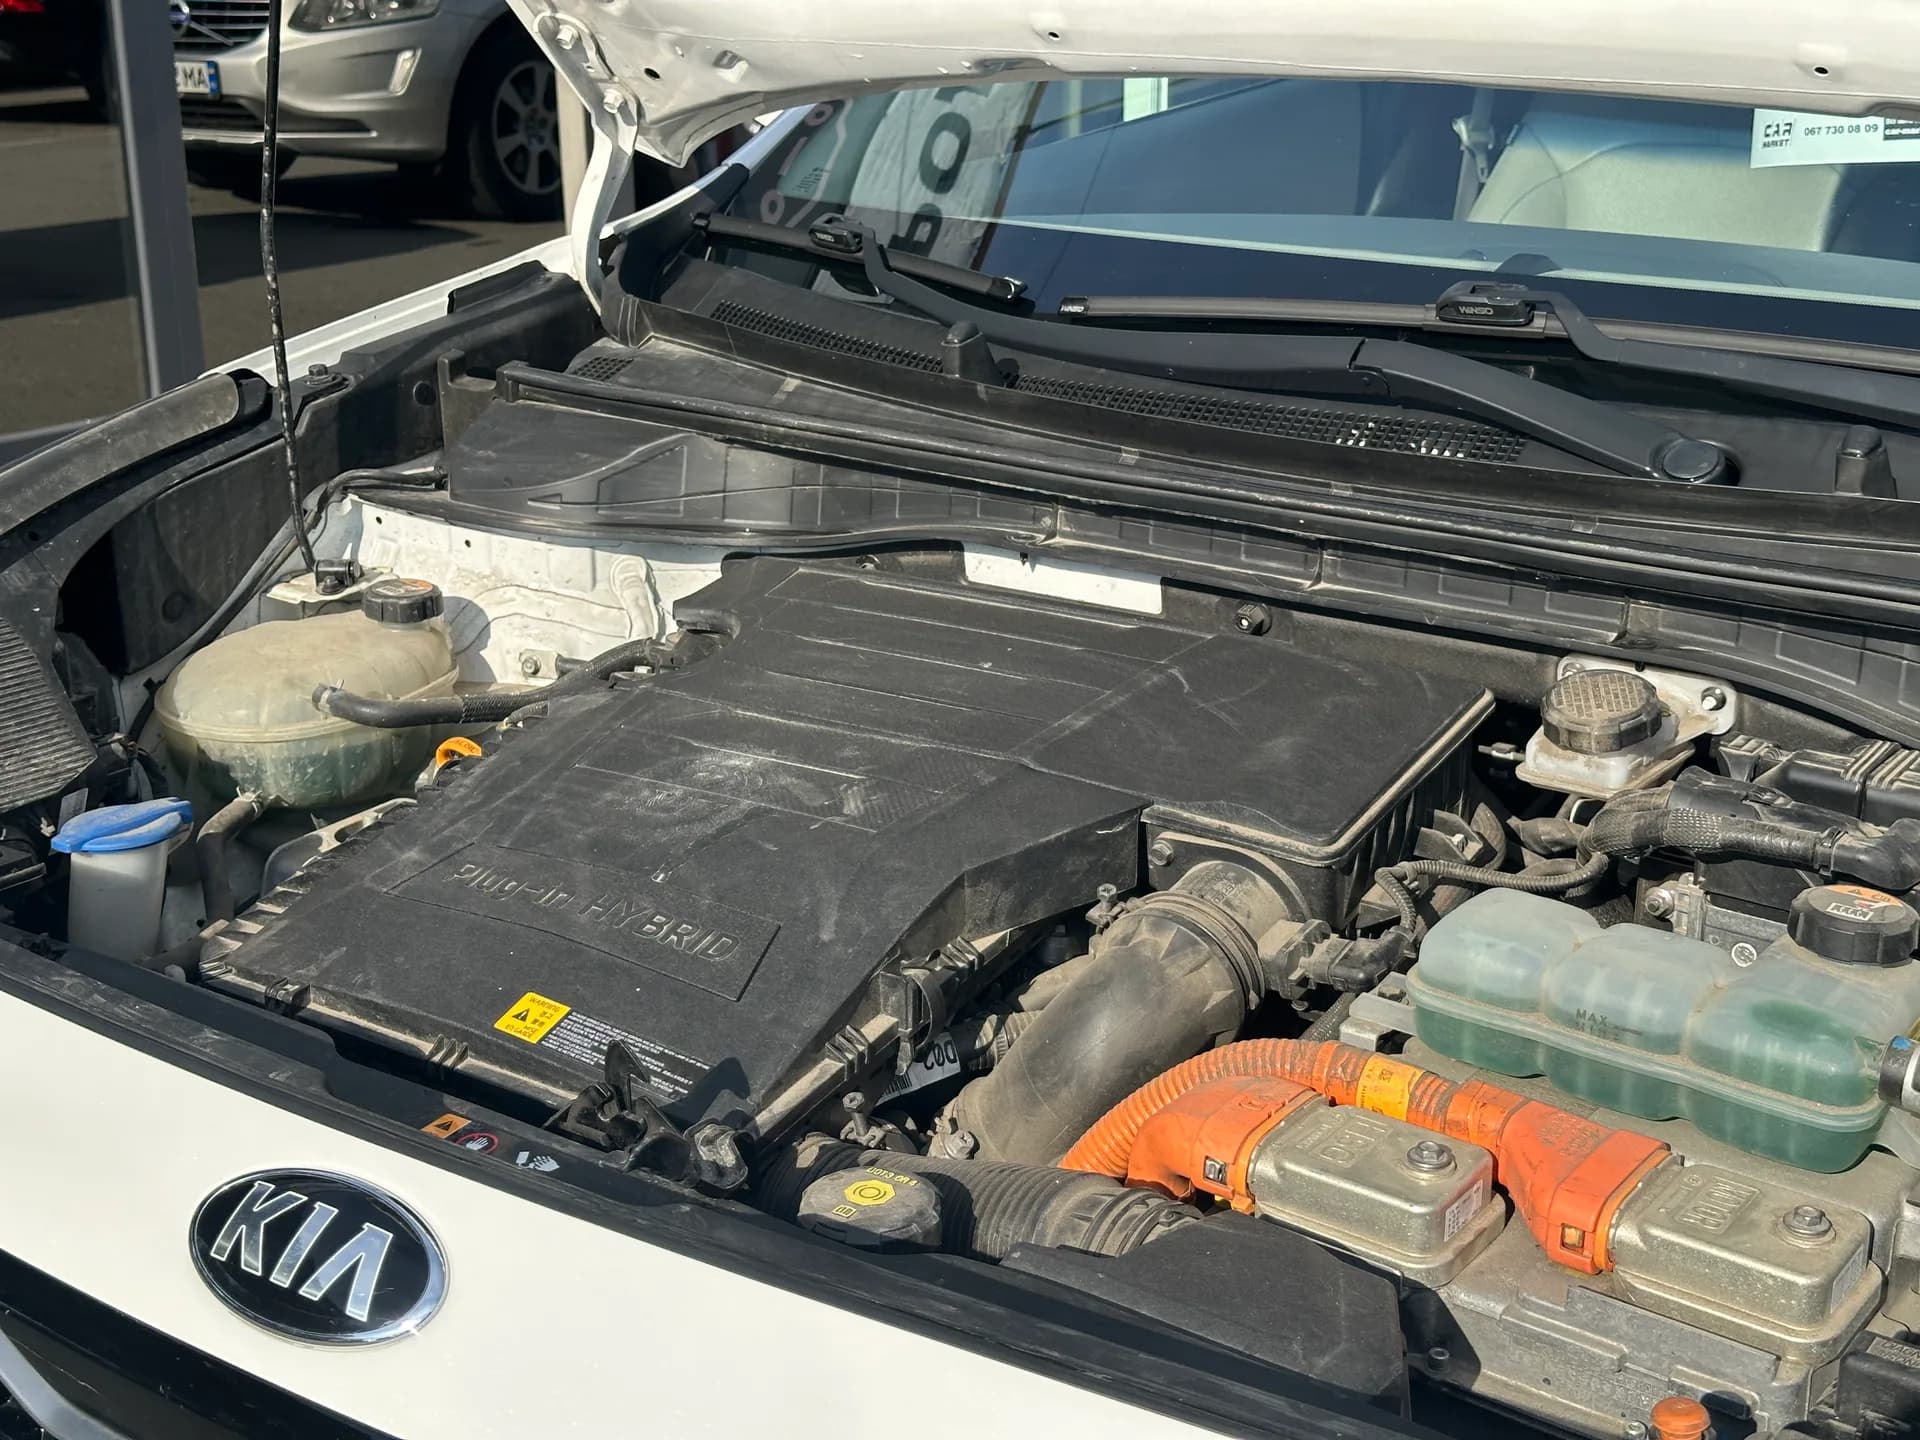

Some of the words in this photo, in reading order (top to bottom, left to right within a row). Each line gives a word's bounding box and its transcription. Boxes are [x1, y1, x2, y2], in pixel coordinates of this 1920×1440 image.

[1804, 127, 1822, 136] 067
[1825, 126, 1844, 134] 730
[1847, 124, 1860, 133] 08
[1864, 124, 1878, 133] 09
[443, 863, 575, 909] Plug-in
[577, 894, 740, 961] HYBRID
[1575, 1008, 1608, 1026] MAX
[210, 1181, 393, 1322] KIA
